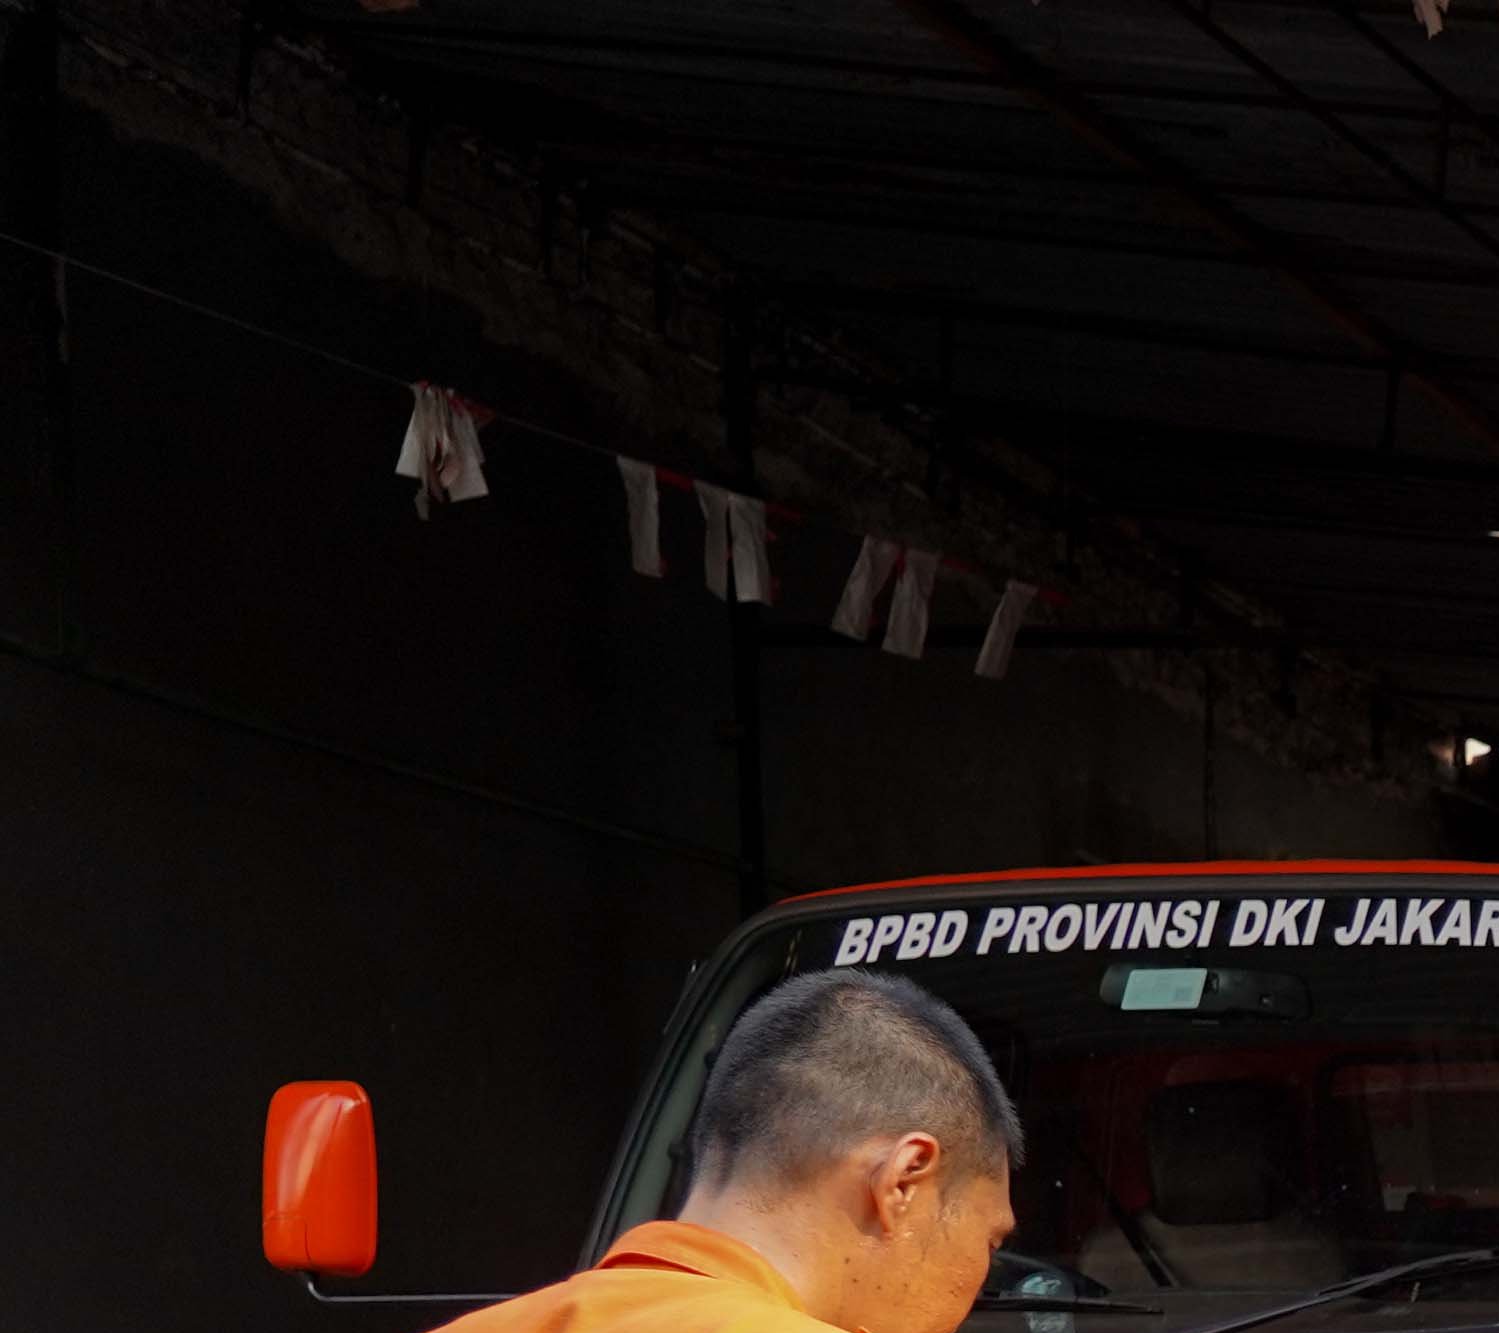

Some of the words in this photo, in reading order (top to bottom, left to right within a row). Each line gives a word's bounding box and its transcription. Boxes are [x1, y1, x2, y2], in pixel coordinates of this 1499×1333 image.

[834, 909, 968, 967] BPBD
[976, 899, 1220, 956] PROVINSI
[1229, 898, 1326, 948] DKI
